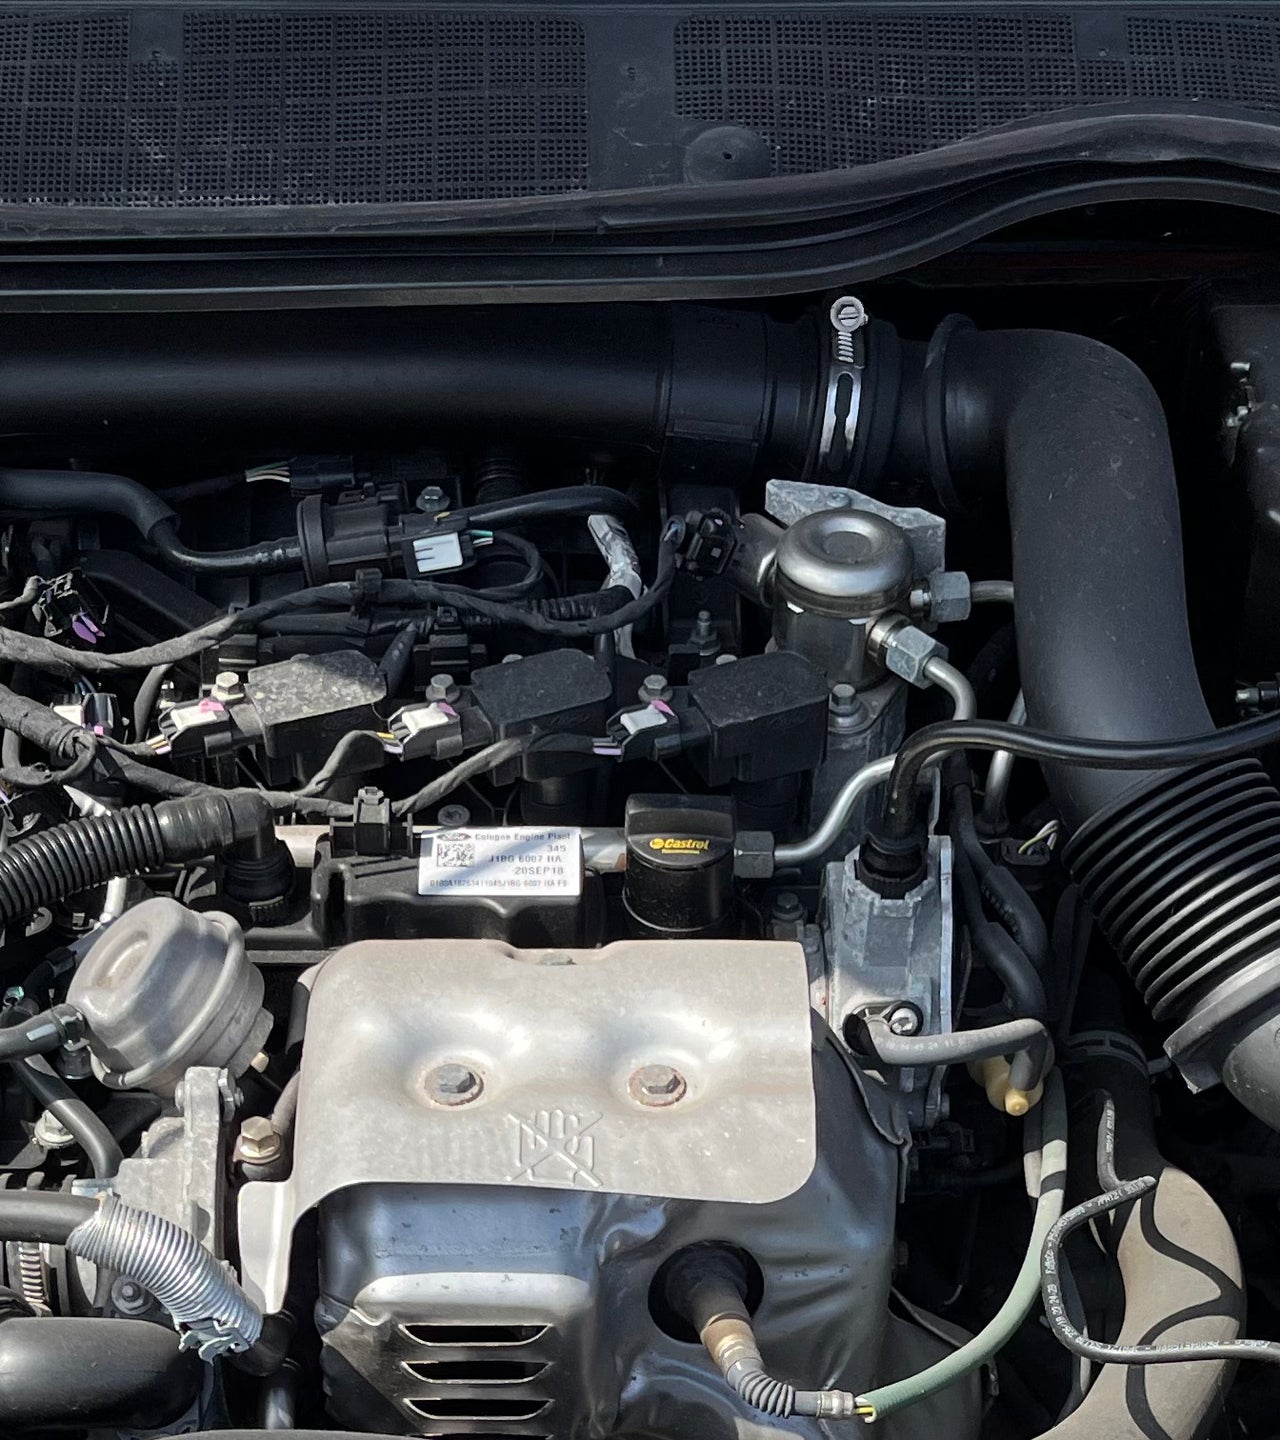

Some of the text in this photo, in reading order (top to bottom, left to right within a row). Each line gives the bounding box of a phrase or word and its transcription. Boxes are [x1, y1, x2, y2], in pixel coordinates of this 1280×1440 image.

[475, 832, 570, 842] Cologne Engine Plant
[664, 838, 710, 850] Castrol
[514, 866, 564, 875] 20SEP18
